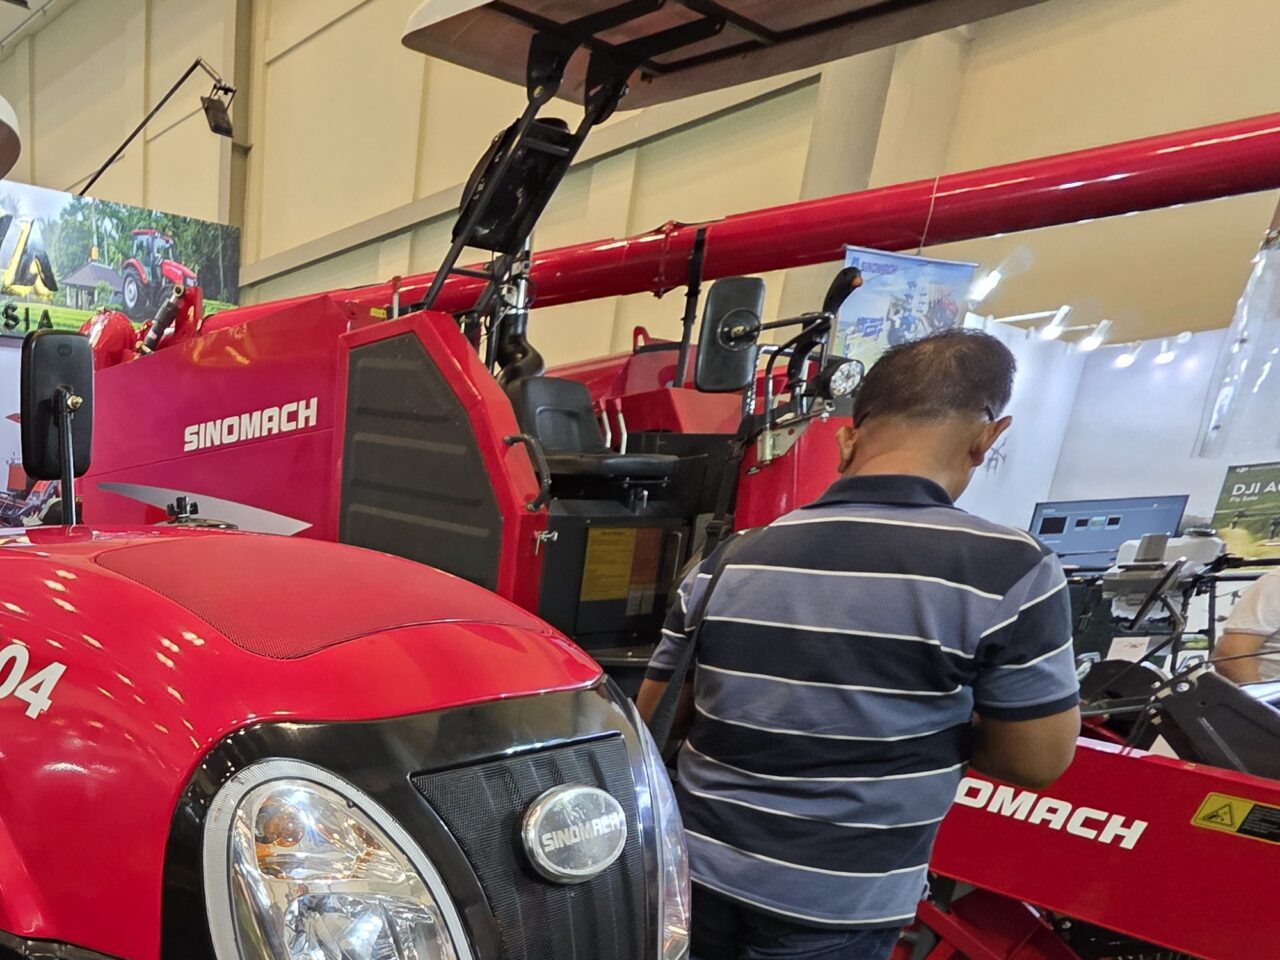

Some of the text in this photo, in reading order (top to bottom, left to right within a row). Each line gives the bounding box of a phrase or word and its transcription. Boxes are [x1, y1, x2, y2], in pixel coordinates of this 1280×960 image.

[183, 397, 319, 452] SINOMACH
[1231, 482, 1262, 495] DJI
[541, 811, 621, 853] SINOMACH
